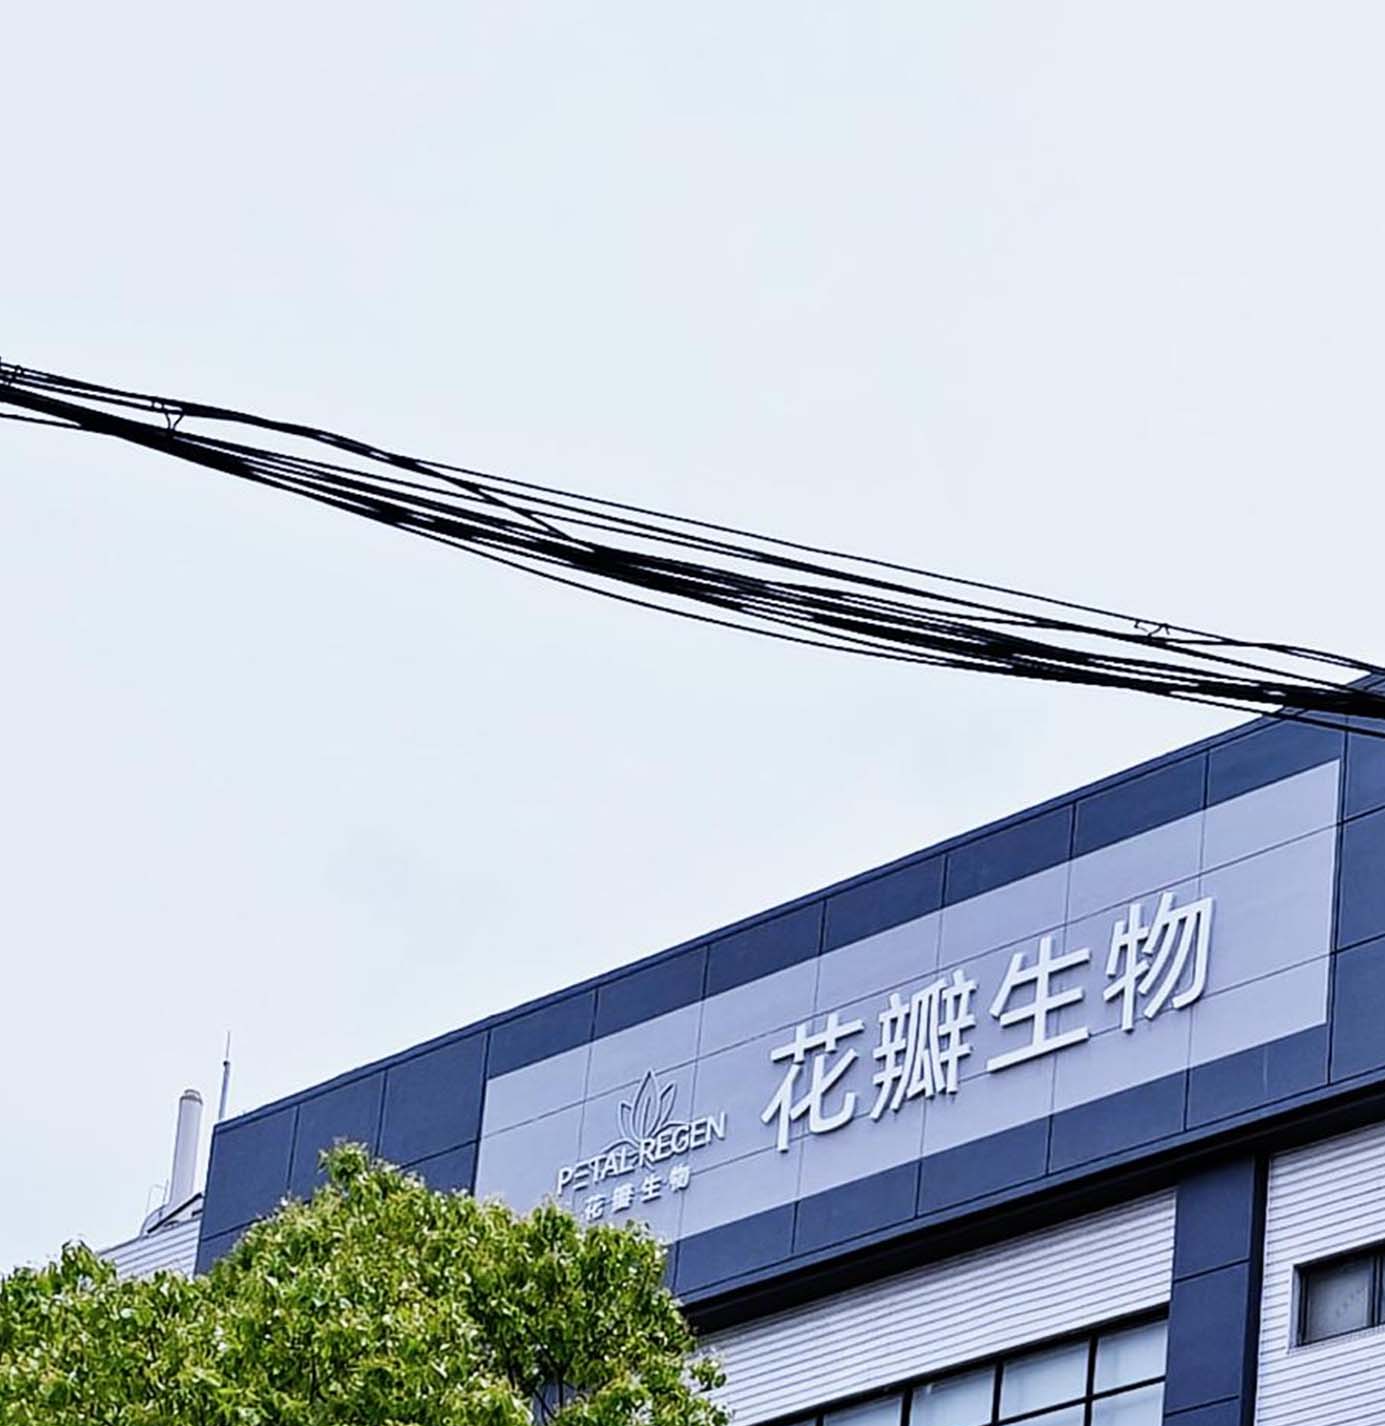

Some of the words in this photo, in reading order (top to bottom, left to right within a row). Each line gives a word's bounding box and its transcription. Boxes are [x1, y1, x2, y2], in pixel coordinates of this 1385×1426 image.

[760, 890, 1217, 1152] 花瓣生物
[557, 1147, 637, 1196] PETAL
[638, 1111, 727, 1168] REGEN
[583, 1163, 691, 1221] 花瓣生物
